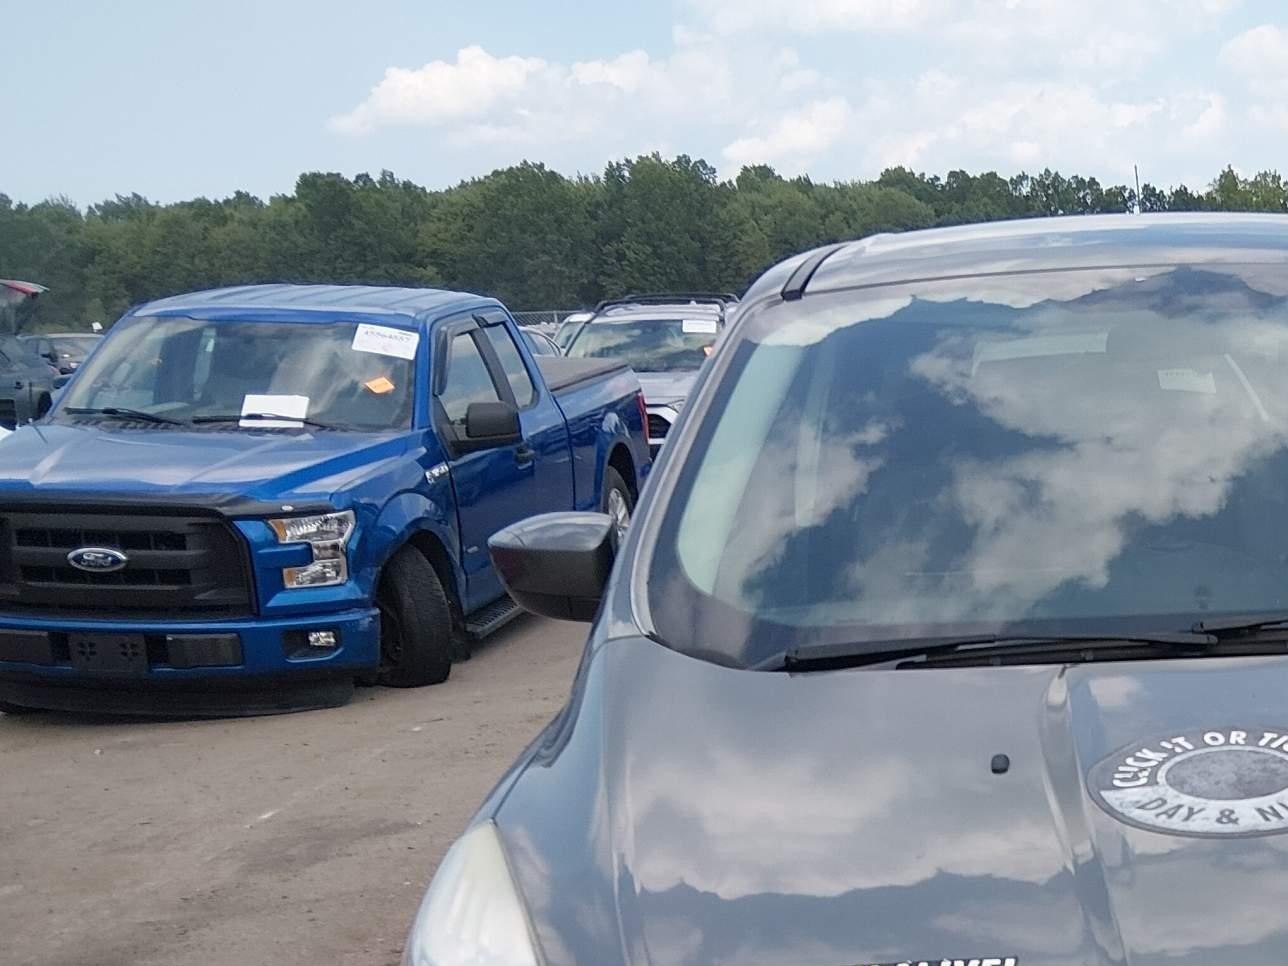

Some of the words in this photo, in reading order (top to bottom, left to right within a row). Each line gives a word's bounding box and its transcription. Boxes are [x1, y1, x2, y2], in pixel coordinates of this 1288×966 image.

[1112, 748, 1168, 788] CLICK
[1203, 730, 1248, 746] OR
[1135, 797, 1203, 822] DAY
[1215, 808, 1240, 825] &
